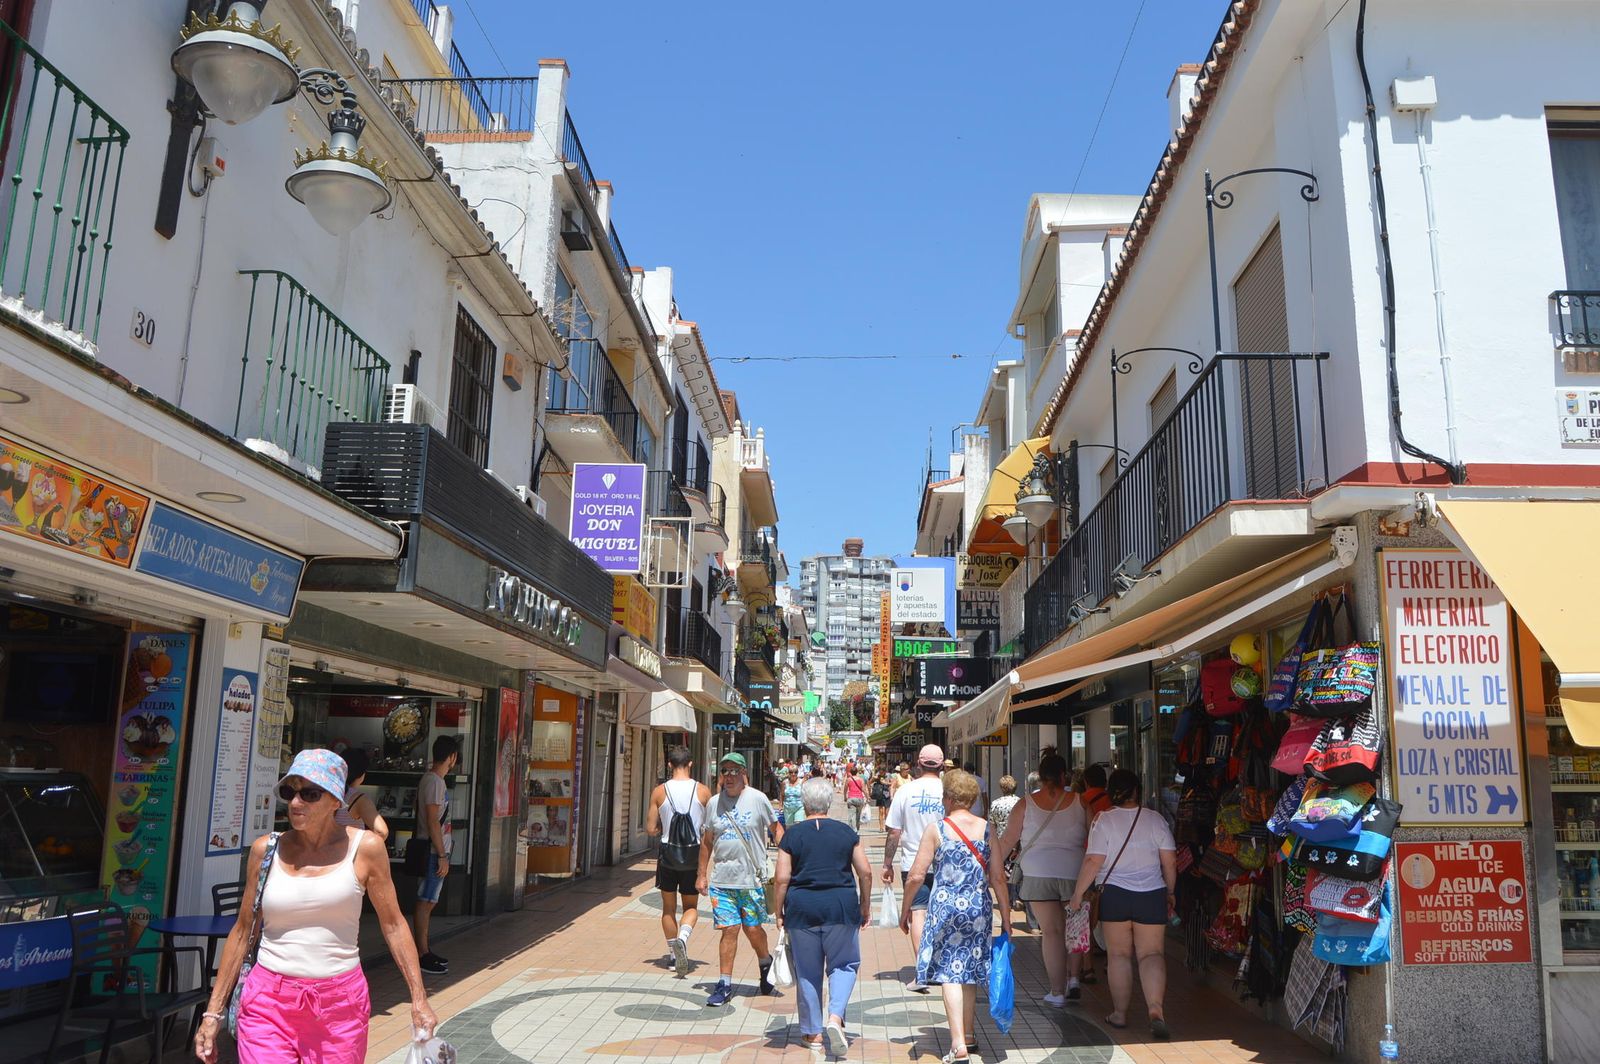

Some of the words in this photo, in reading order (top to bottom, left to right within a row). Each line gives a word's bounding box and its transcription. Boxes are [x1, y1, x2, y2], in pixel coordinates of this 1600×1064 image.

[135, 311, 155, 345] 30
[1576, 418, 1588, 428] DE
[579, 504, 634, 516] JOYERIA
[587, 518, 622, 531] DON
[144, 523, 198, 565] HELADOS
[572, 537, 638, 550] MIGUEL
[195, 543, 253, 584] ARTESANOS
[1386, 560, 1497, 589] FERRETERI
[904, 602, 938, 610] apuestas
[1403, 597, 1490, 627] MATERIAL
[1399, 634, 1500, 665] ELECTRICO
[1339, 666, 1354, 678] SOL
[228, 687, 251, 700] helados
[933, 685, 947, 695] MY
[949, 684, 982, 695] PHONE
[1396, 674, 1471, 706] MENAJE
[1483, 674, 1507, 706] DE
[138, 701, 176, 712] TULIPA
[1422, 710, 1490, 741] COCINA
[1398, 747, 1439, 776] LOZA
[1454, 747, 1519, 776] CRISTAL
[122, 773, 169, 783] TARRINAS
[1443, 784, 1478, 815] MTS
[1434, 844, 1494, 861] HIELO
[1478, 860, 1504, 874] ICE
[1438, 877, 1495, 894] AGUA
[1418, 894, 1474, 908] WATER
[1405, 909, 1473, 923] BEBIDAS
[1478, 906, 1525, 922] FRÍAS
[1441, 922, 1473, 933] COLD
[1477, 921, 1523, 932] DRINKS
[1421, 938, 1514, 953] REFRESCOS
[20, 946, 73, 967] Artesan
[1414, 951, 1446, 963] SOFT
[1449, 951, 1488, 962] DRINK
